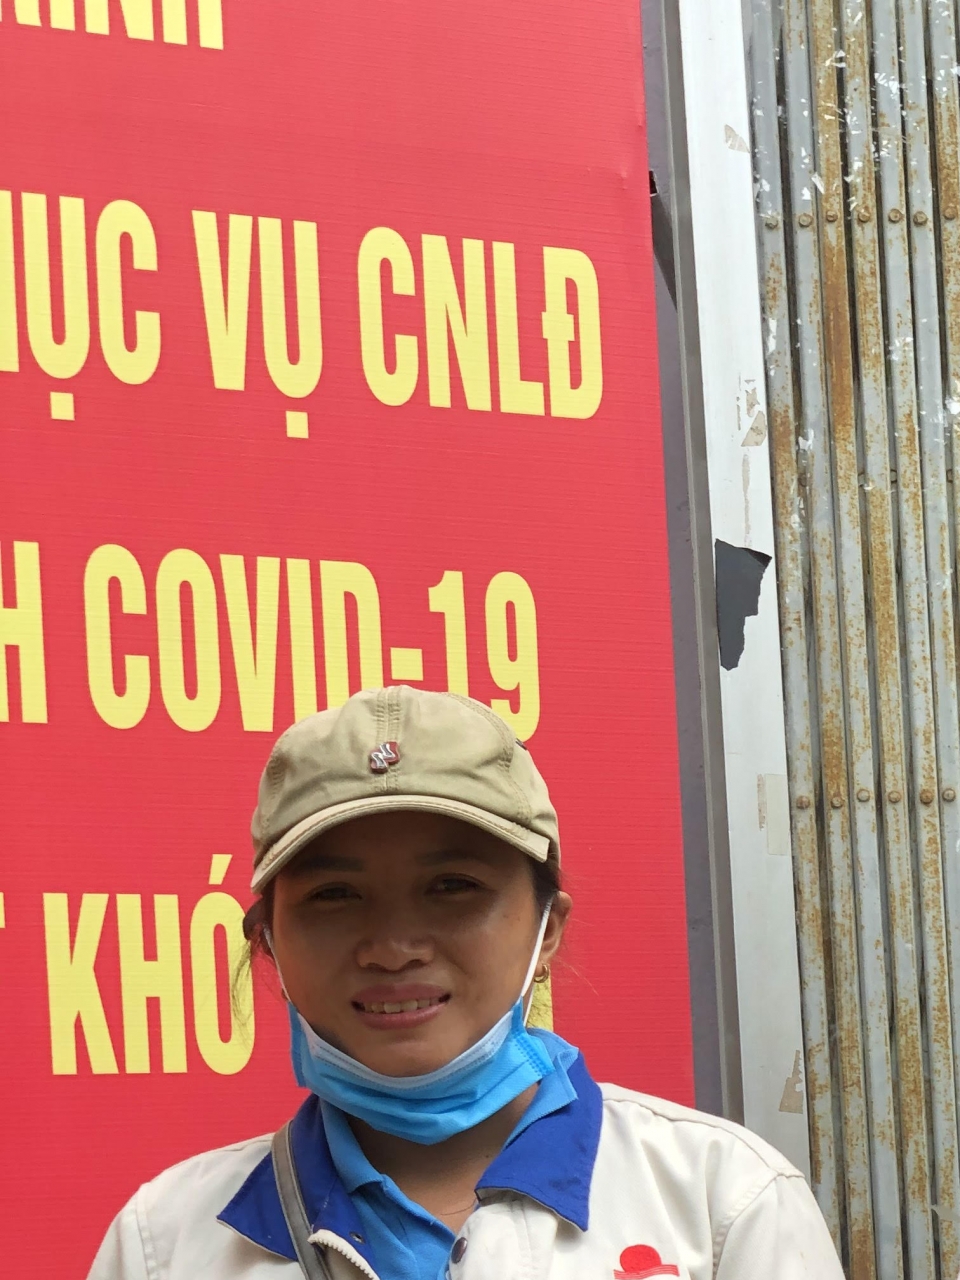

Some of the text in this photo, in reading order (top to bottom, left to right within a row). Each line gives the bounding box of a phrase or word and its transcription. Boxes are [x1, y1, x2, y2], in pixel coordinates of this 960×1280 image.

[193, 211, 322, 438] VỤ
[358, 227, 602, 418] CNLĐ
[84, 543, 540, 741] COVID-19
[44, 854, 255, 1075] KHÓ
